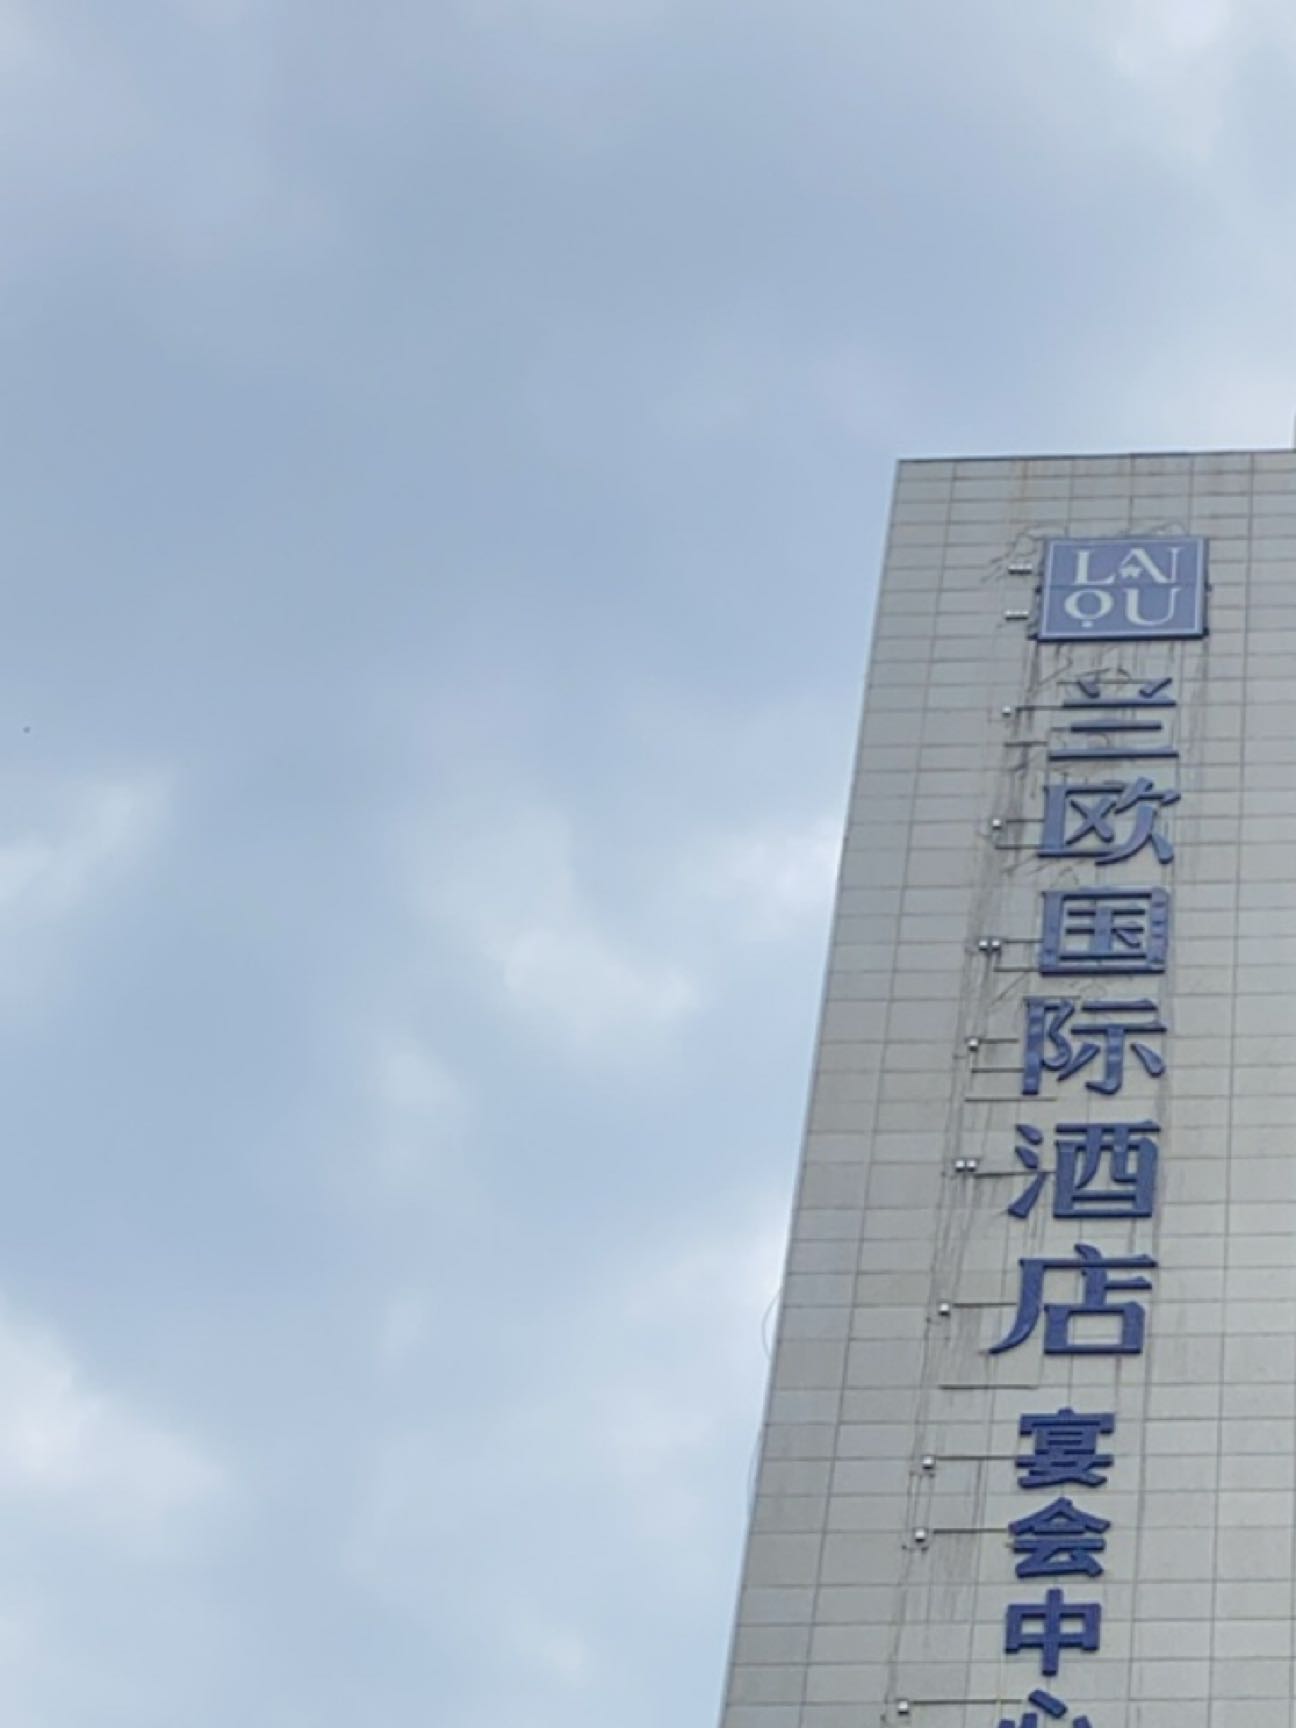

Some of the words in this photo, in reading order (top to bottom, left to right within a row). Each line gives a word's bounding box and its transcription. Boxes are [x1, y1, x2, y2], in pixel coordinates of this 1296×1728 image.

[988, 677, 1181, 1355] 兰欧国际酒店
